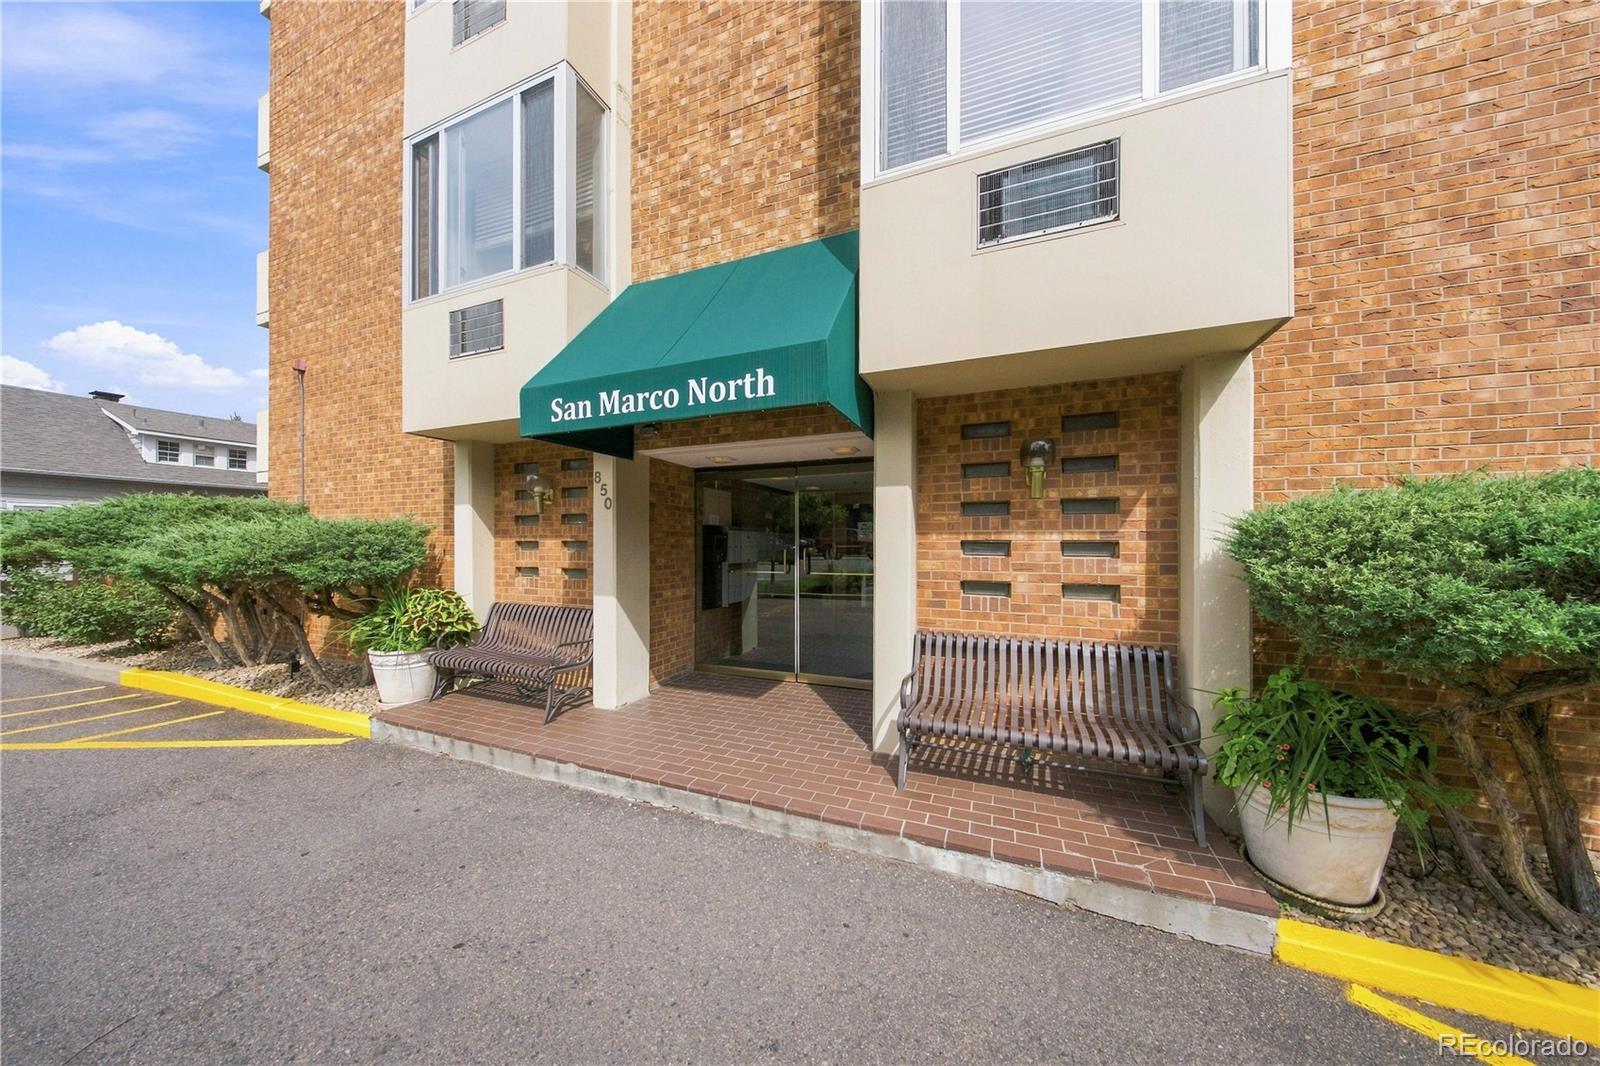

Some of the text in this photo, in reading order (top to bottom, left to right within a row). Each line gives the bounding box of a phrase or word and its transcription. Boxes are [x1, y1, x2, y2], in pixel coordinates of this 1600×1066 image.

[550, 368, 776, 423] San Marco North
[594, 471, 613, 510] 850
